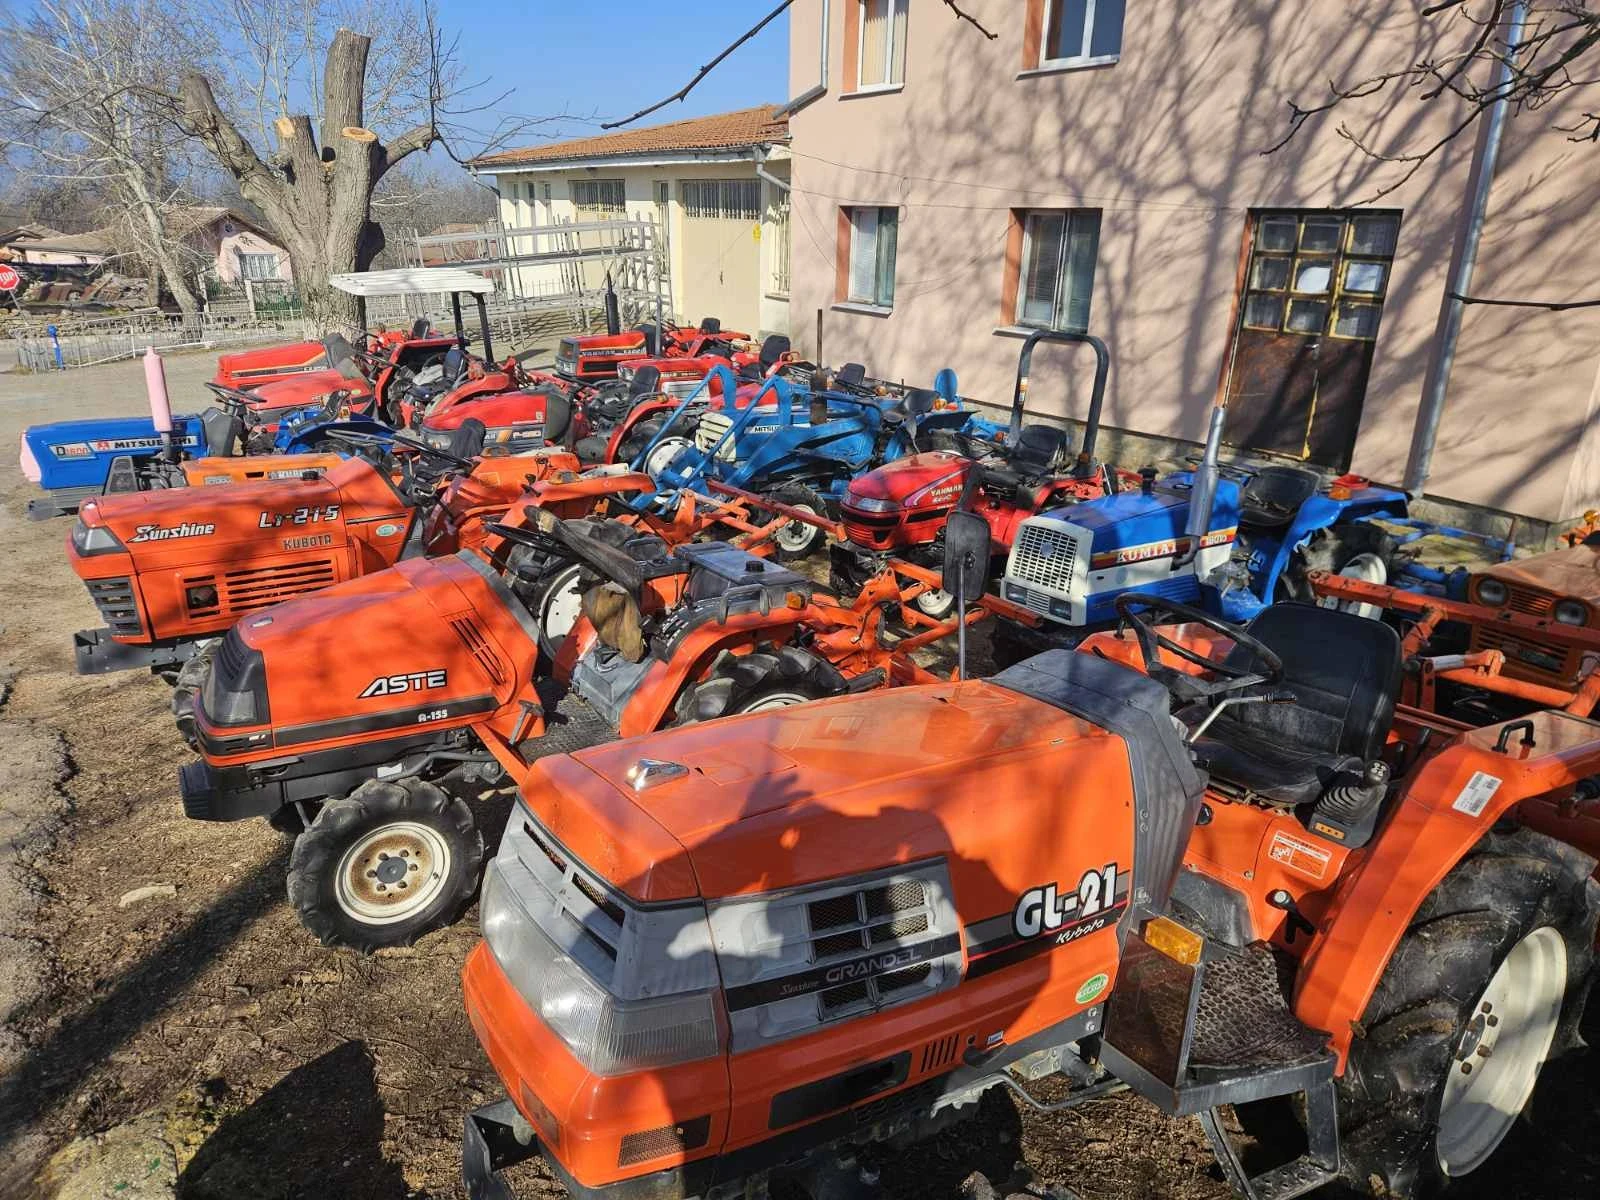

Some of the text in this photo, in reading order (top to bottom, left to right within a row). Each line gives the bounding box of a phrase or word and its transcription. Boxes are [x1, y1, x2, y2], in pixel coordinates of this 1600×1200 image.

[114, 436, 192, 449] MITSUBSHI
[931, 484, 964, 497] YANMAR
[126, 522, 215, 543] Sunshine
[282, 533, 333, 550] KUBOTA
[357, 668, 448, 699] ASTE
[418, 709, 448, 723] A-155
[1012, 862, 1118, 939] GL-21
[1055, 918, 1105, 945] Kubota
[826, 947, 922, 982] GRANDEL
